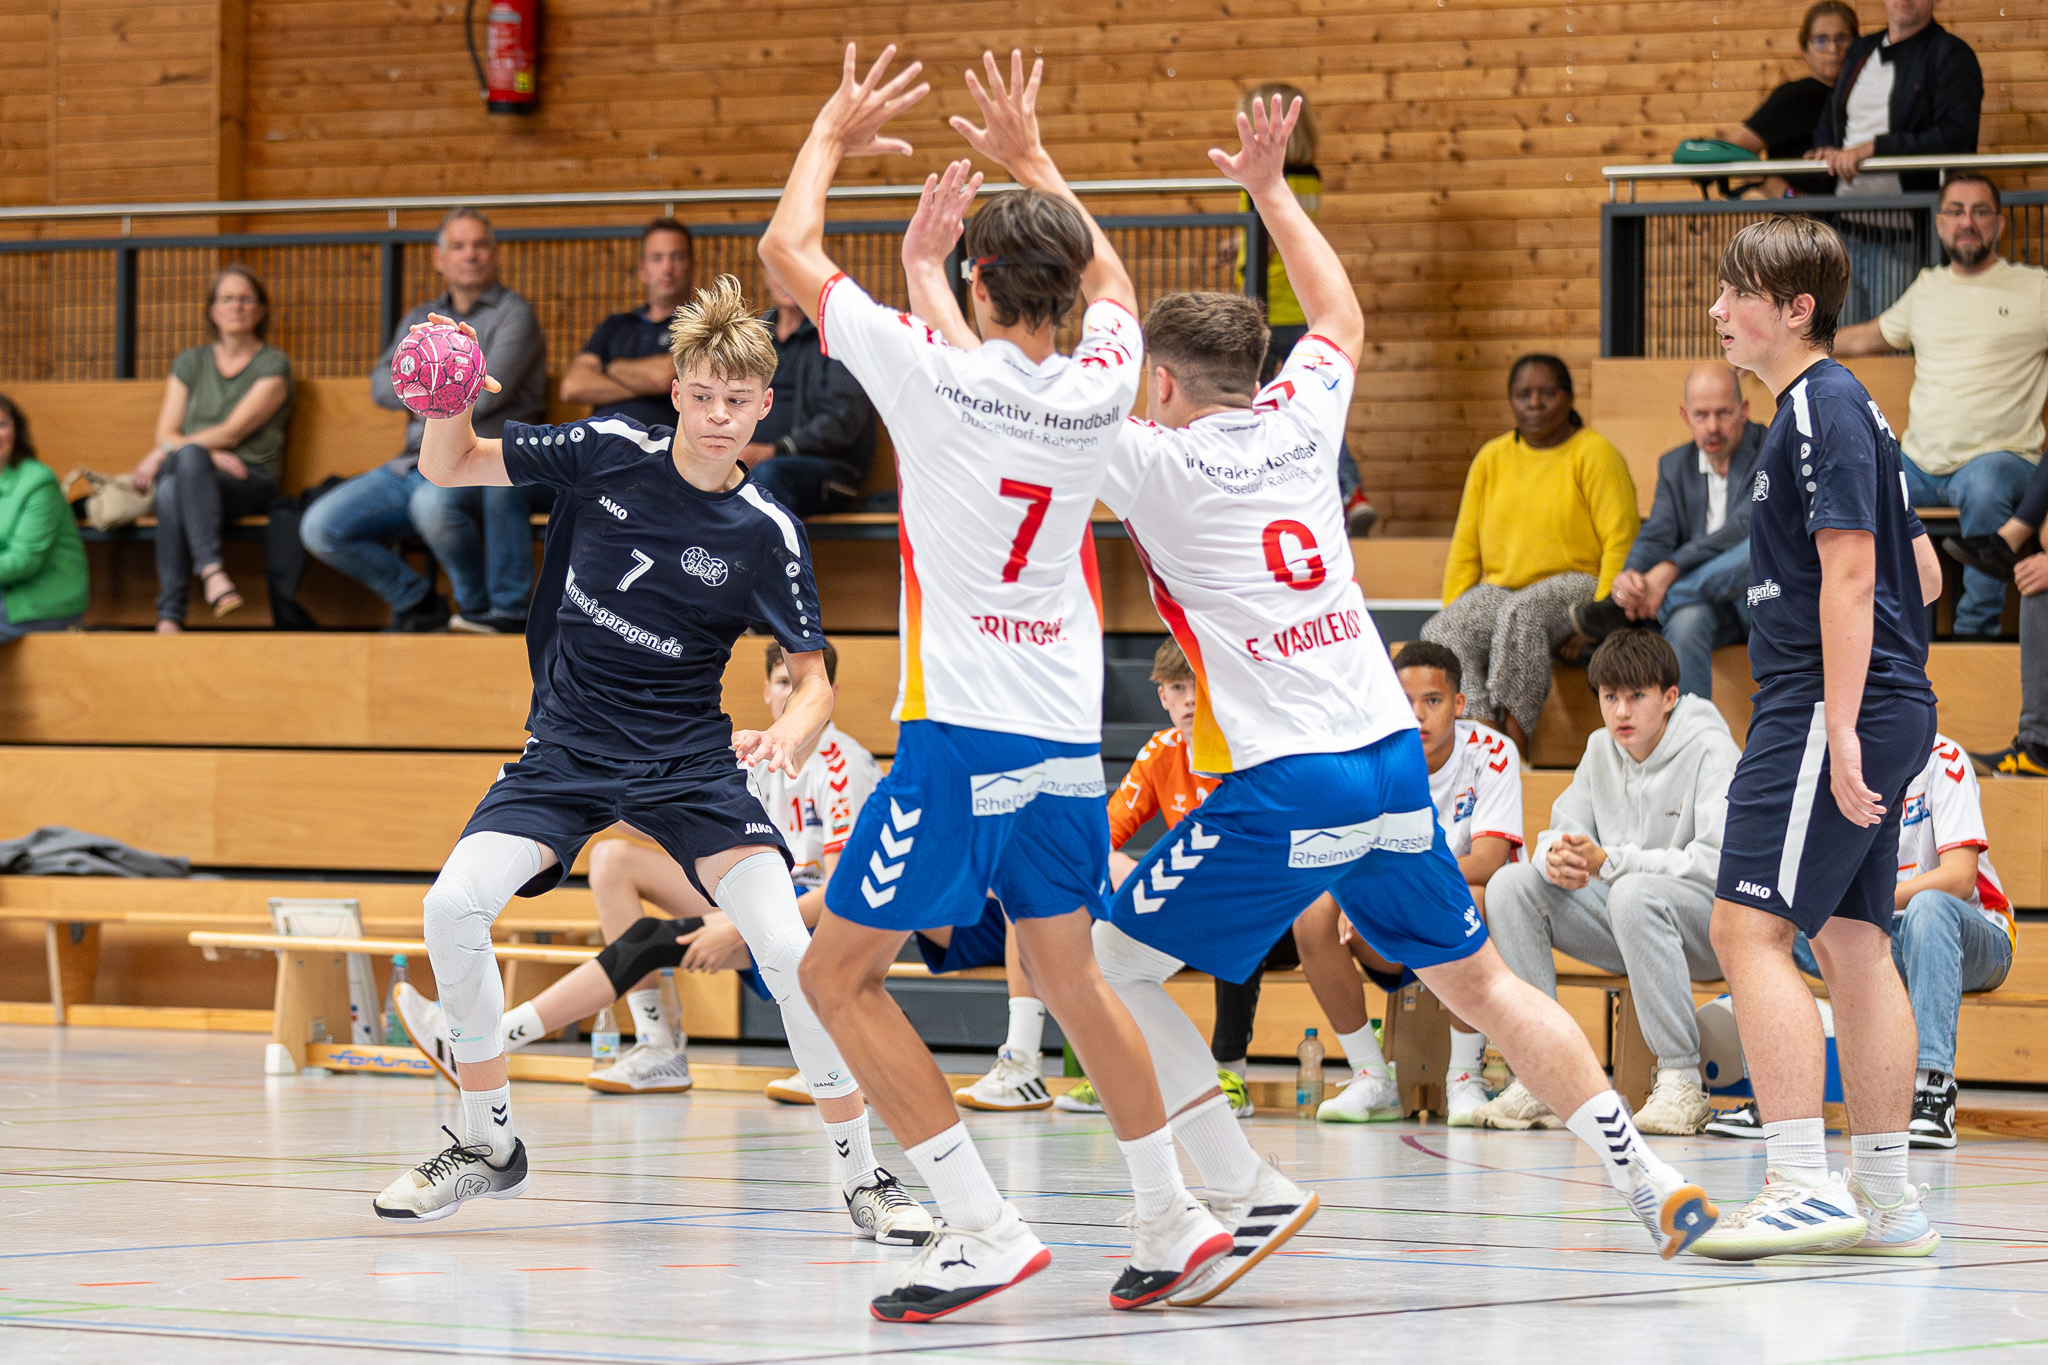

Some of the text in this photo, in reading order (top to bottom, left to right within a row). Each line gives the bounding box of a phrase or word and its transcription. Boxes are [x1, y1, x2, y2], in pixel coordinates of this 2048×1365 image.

[1044, 405, 1120, 431] Handball
[598, 495, 628, 521] JAKO
[999, 477, 1053, 583] 7
[616, 548, 655, 592] 7
[567, 582, 684, 657] maxi-garagen.de
[745, 822, 774, 835] JAKO
[1735, 880, 1772, 899] JAKO
